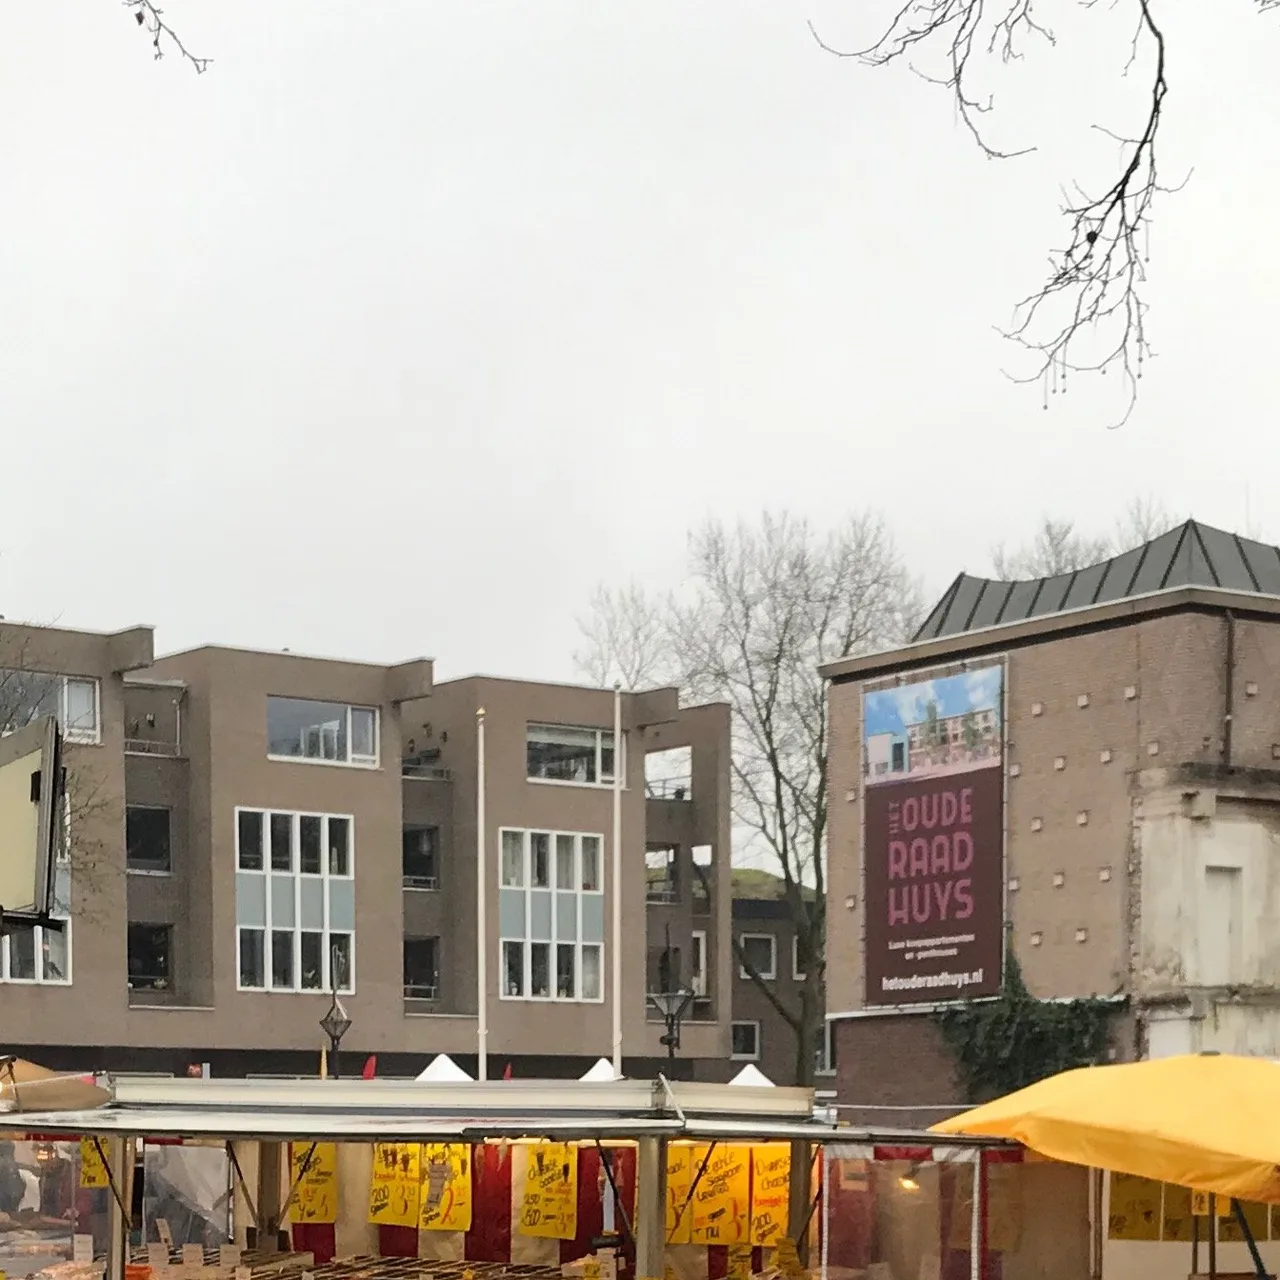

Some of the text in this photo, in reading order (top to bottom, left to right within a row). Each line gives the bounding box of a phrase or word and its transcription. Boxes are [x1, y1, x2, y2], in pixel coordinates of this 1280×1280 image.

[903, 788, 973, 832] OUDE
[888, 831, 974, 880] RAAD
[888, 878, 974, 927] HUYS
[882, 968, 984, 991] hetouderaadhuys.nl
